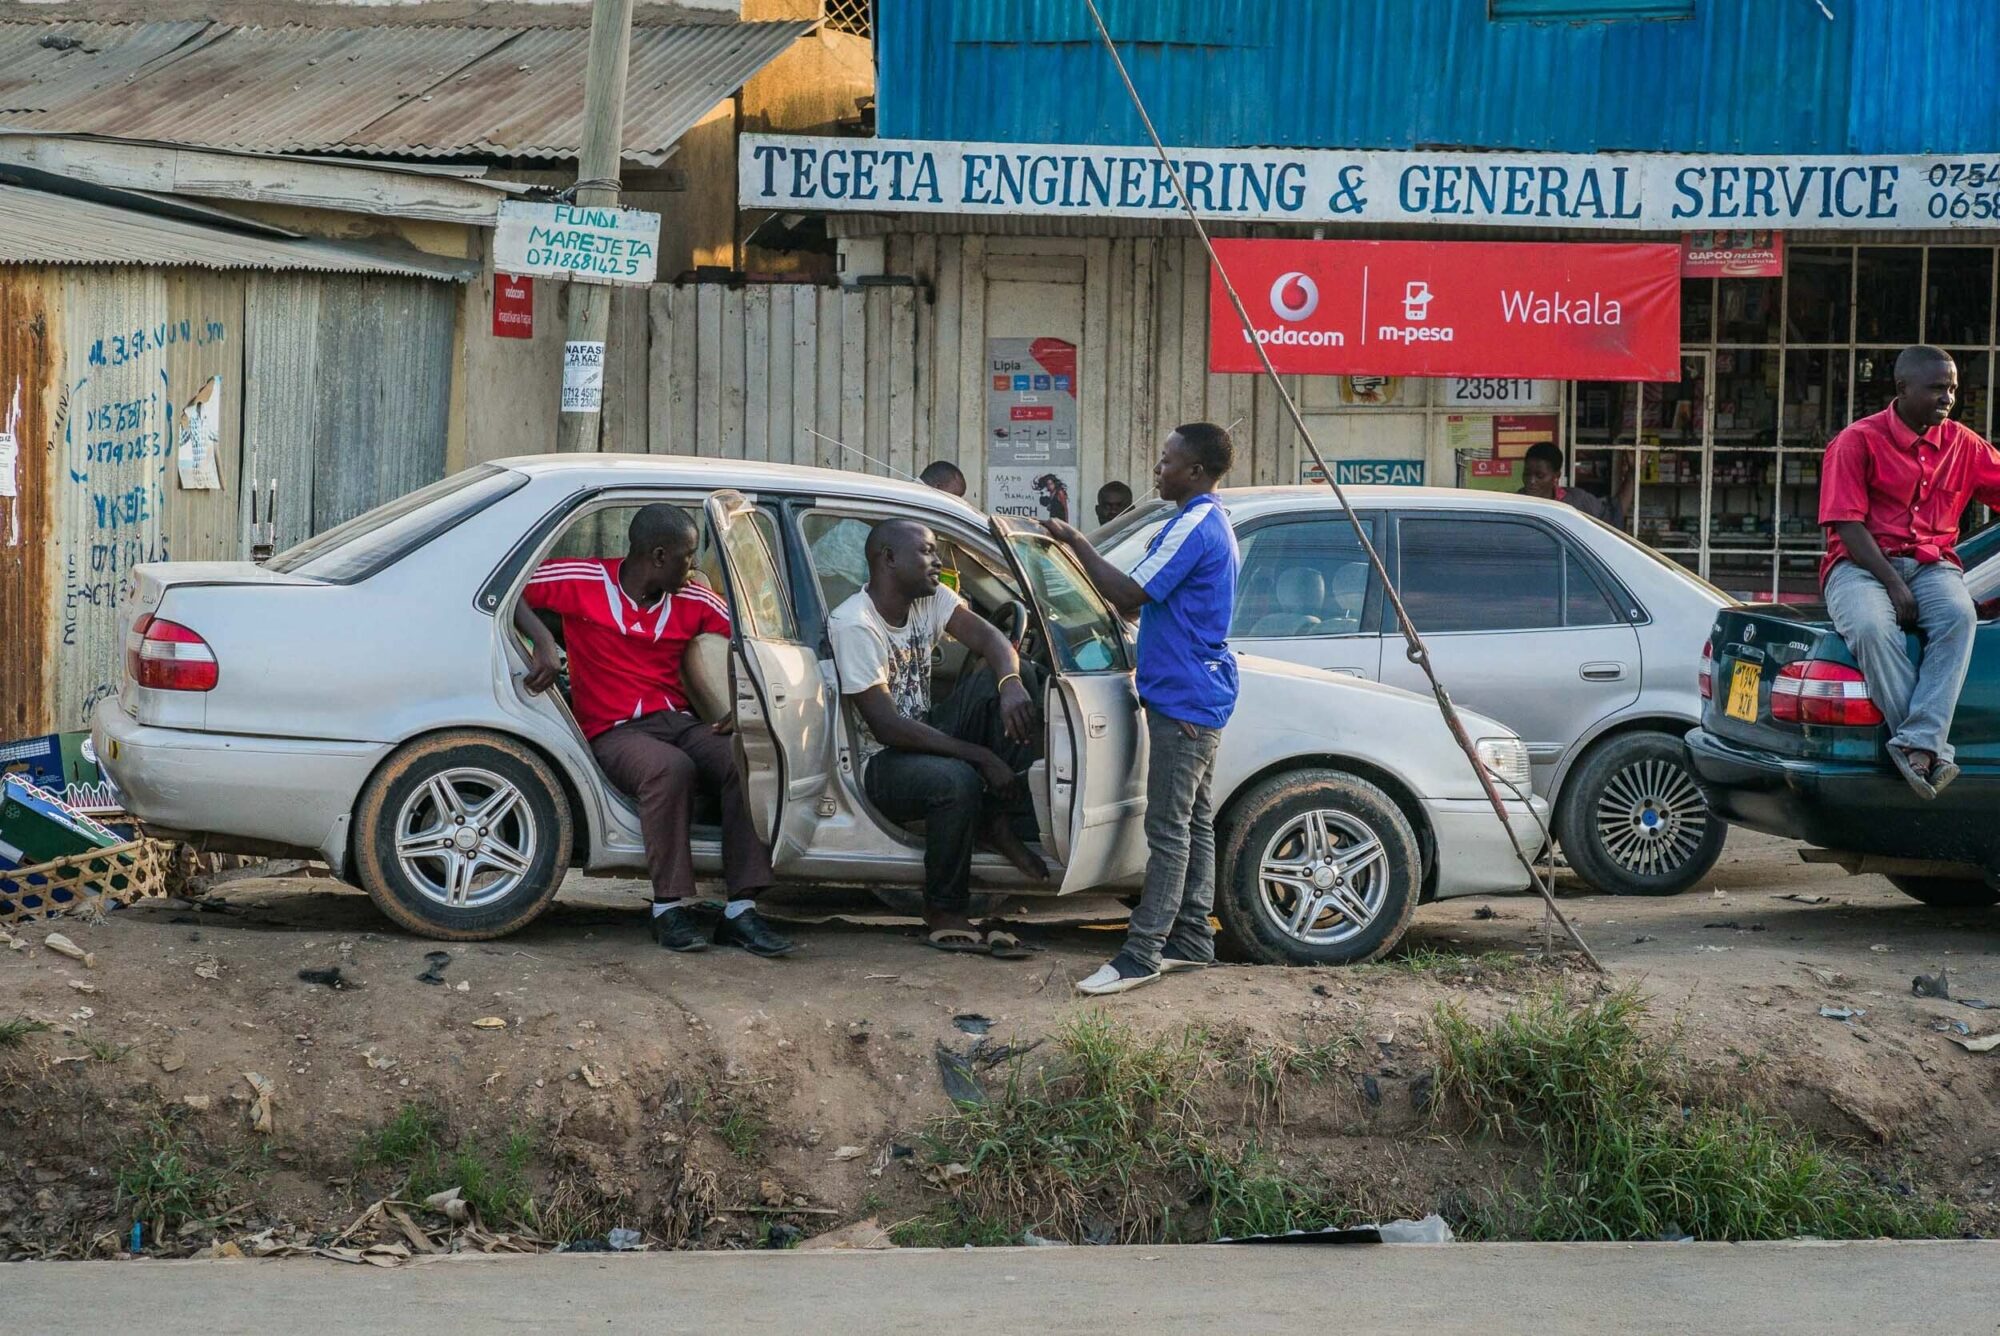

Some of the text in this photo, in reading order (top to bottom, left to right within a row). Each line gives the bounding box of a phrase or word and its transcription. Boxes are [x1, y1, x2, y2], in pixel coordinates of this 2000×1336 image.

[753, 145, 1899, 220] TEGETA ENGINEERING & GENERAL SERVICE
[526, 248, 639, 275] 0718681425
[1688, 251, 1733, 260] GAPCO
[1500, 290, 1622, 325] Wakala
[1242, 325, 1345, 347] vodacom
[1378, 326, 1454, 345] m-pesa
[1456, 378, 1534, 400] 235811
[1340, 464, 1423, 485] NISSAN
[995, 506, 1038, 517] SWITCH
